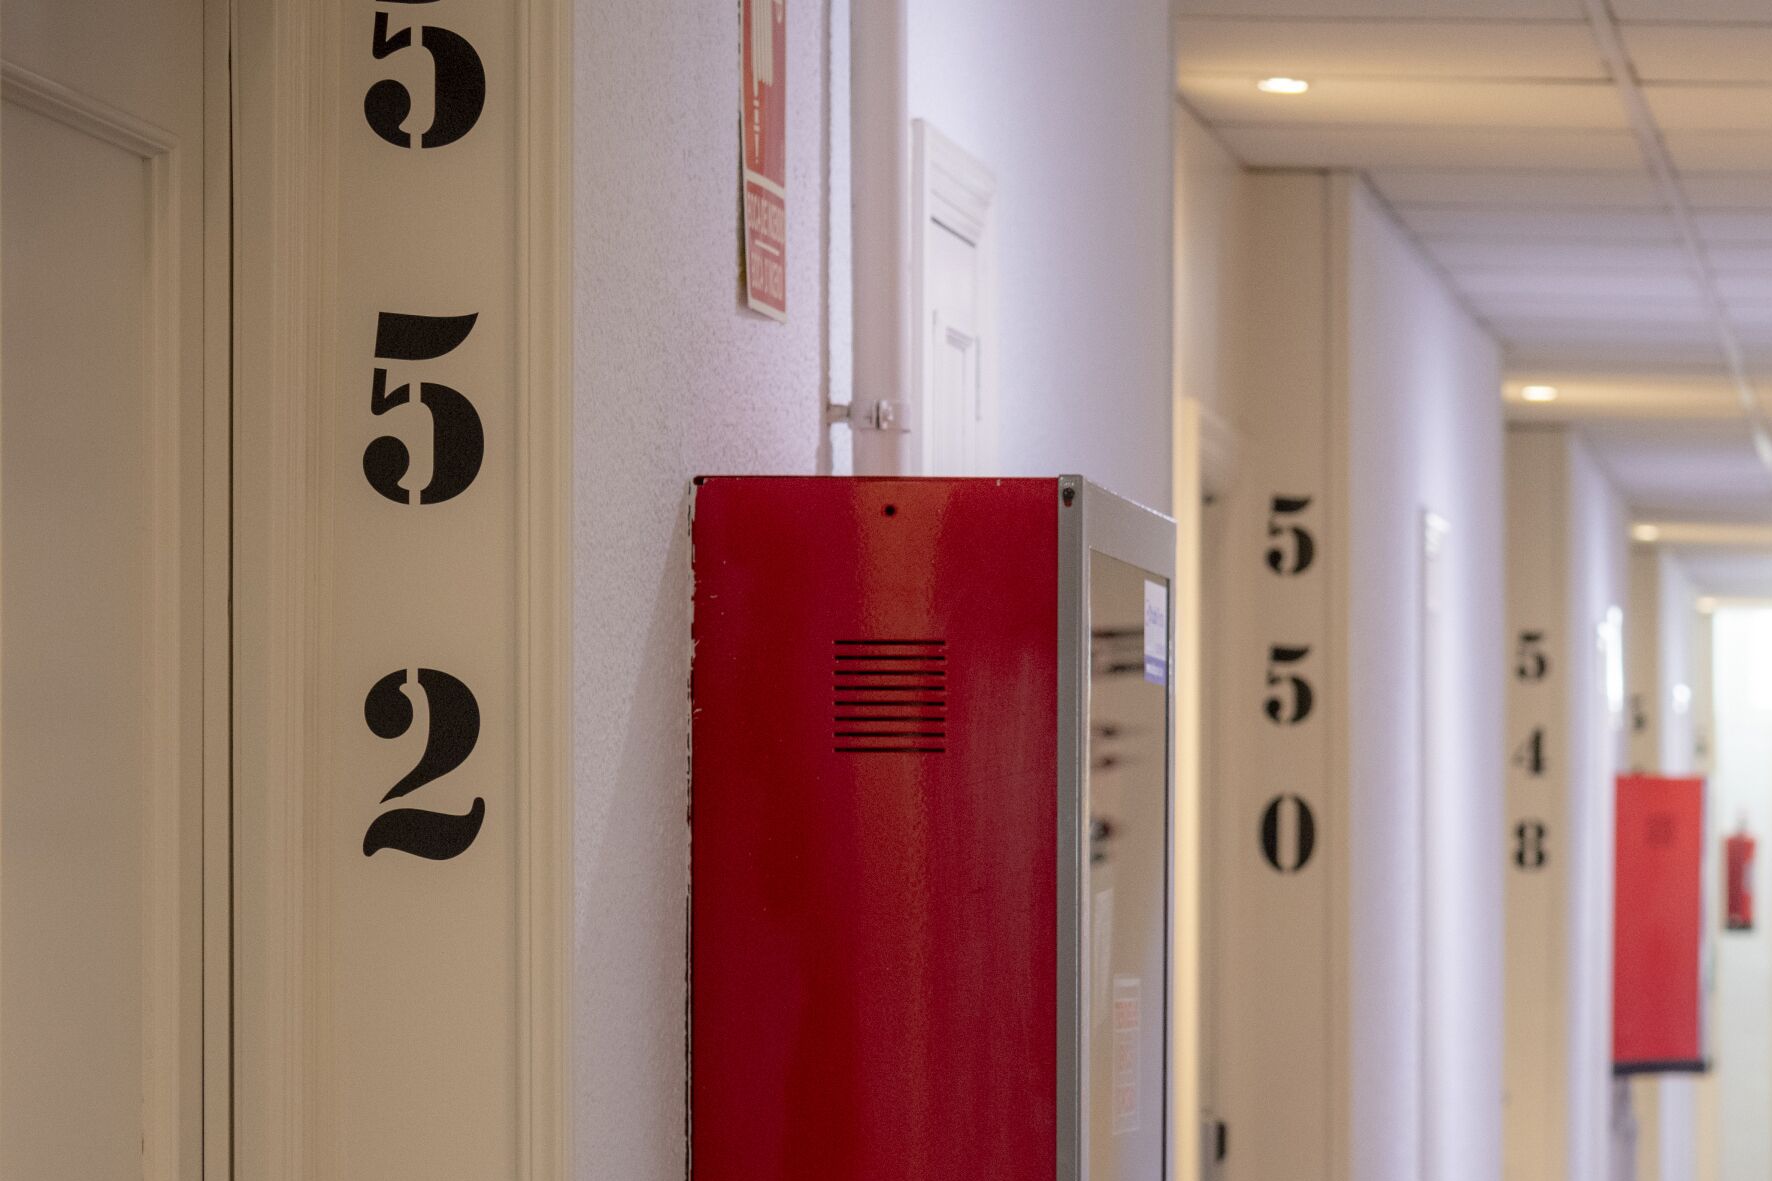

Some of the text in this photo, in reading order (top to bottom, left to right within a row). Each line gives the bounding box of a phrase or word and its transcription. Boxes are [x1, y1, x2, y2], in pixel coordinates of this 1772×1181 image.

[362, 0, 486, 860] 552
[1258, 493, 1317, 874] 550
[1513, 631, 1548, 870] 548
